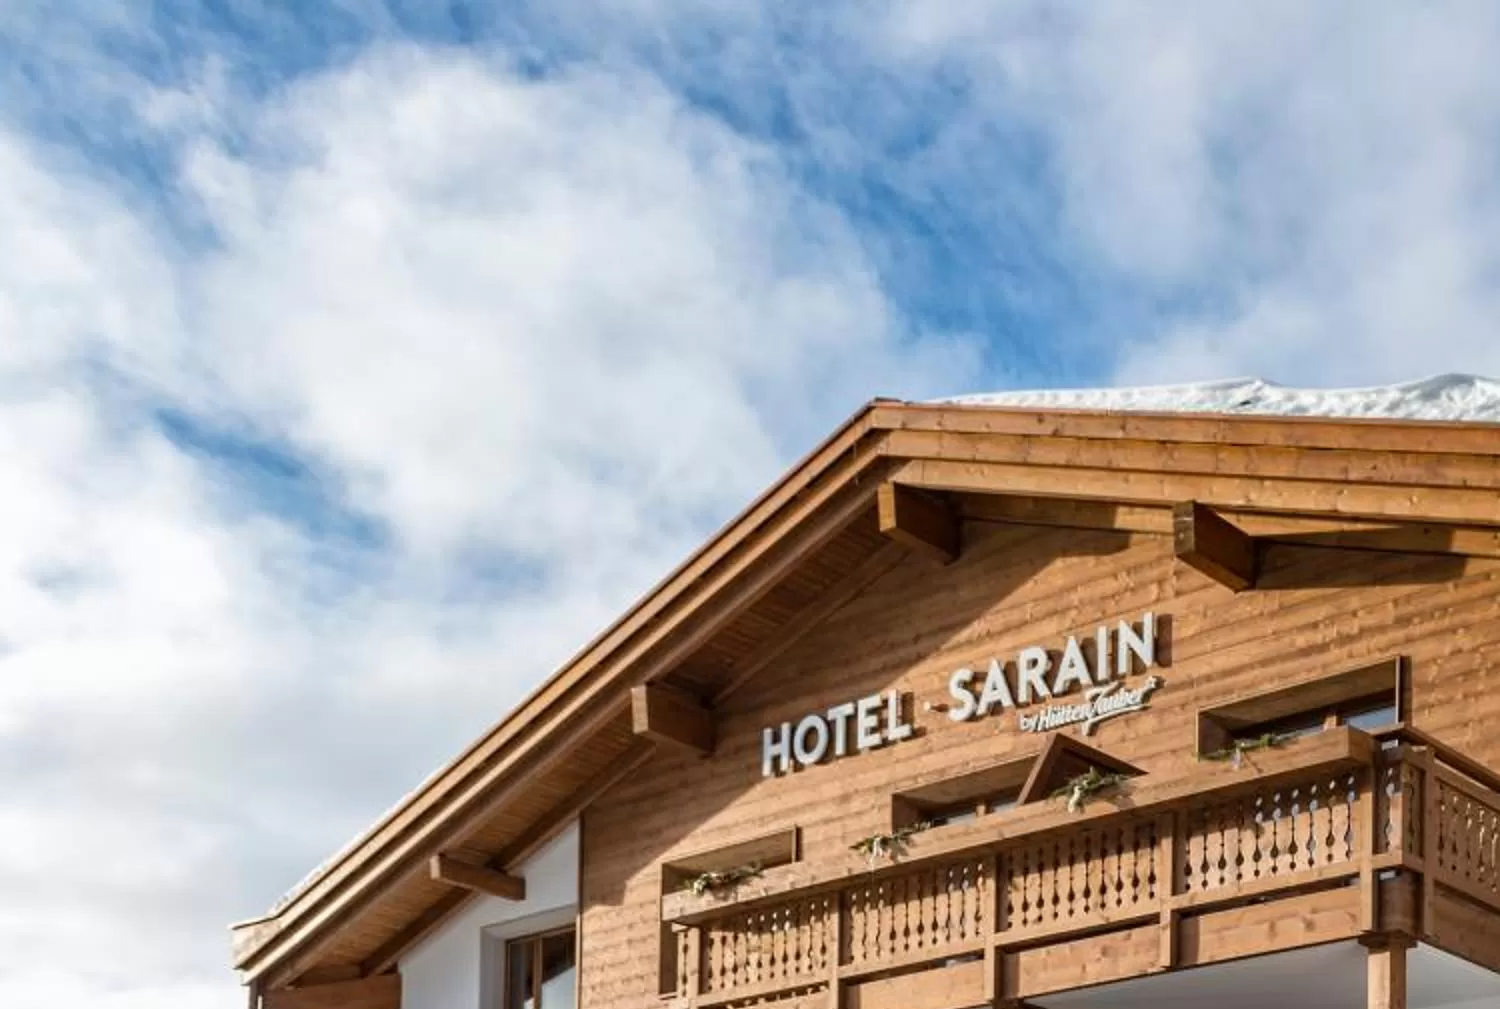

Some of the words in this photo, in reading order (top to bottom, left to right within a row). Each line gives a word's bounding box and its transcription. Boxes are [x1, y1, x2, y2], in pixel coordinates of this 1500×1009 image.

[761, 688, 913, 777] HOTEL
[948, 611, 1157, 722] SARAIN
[1019, 711, 1040, 733] by
